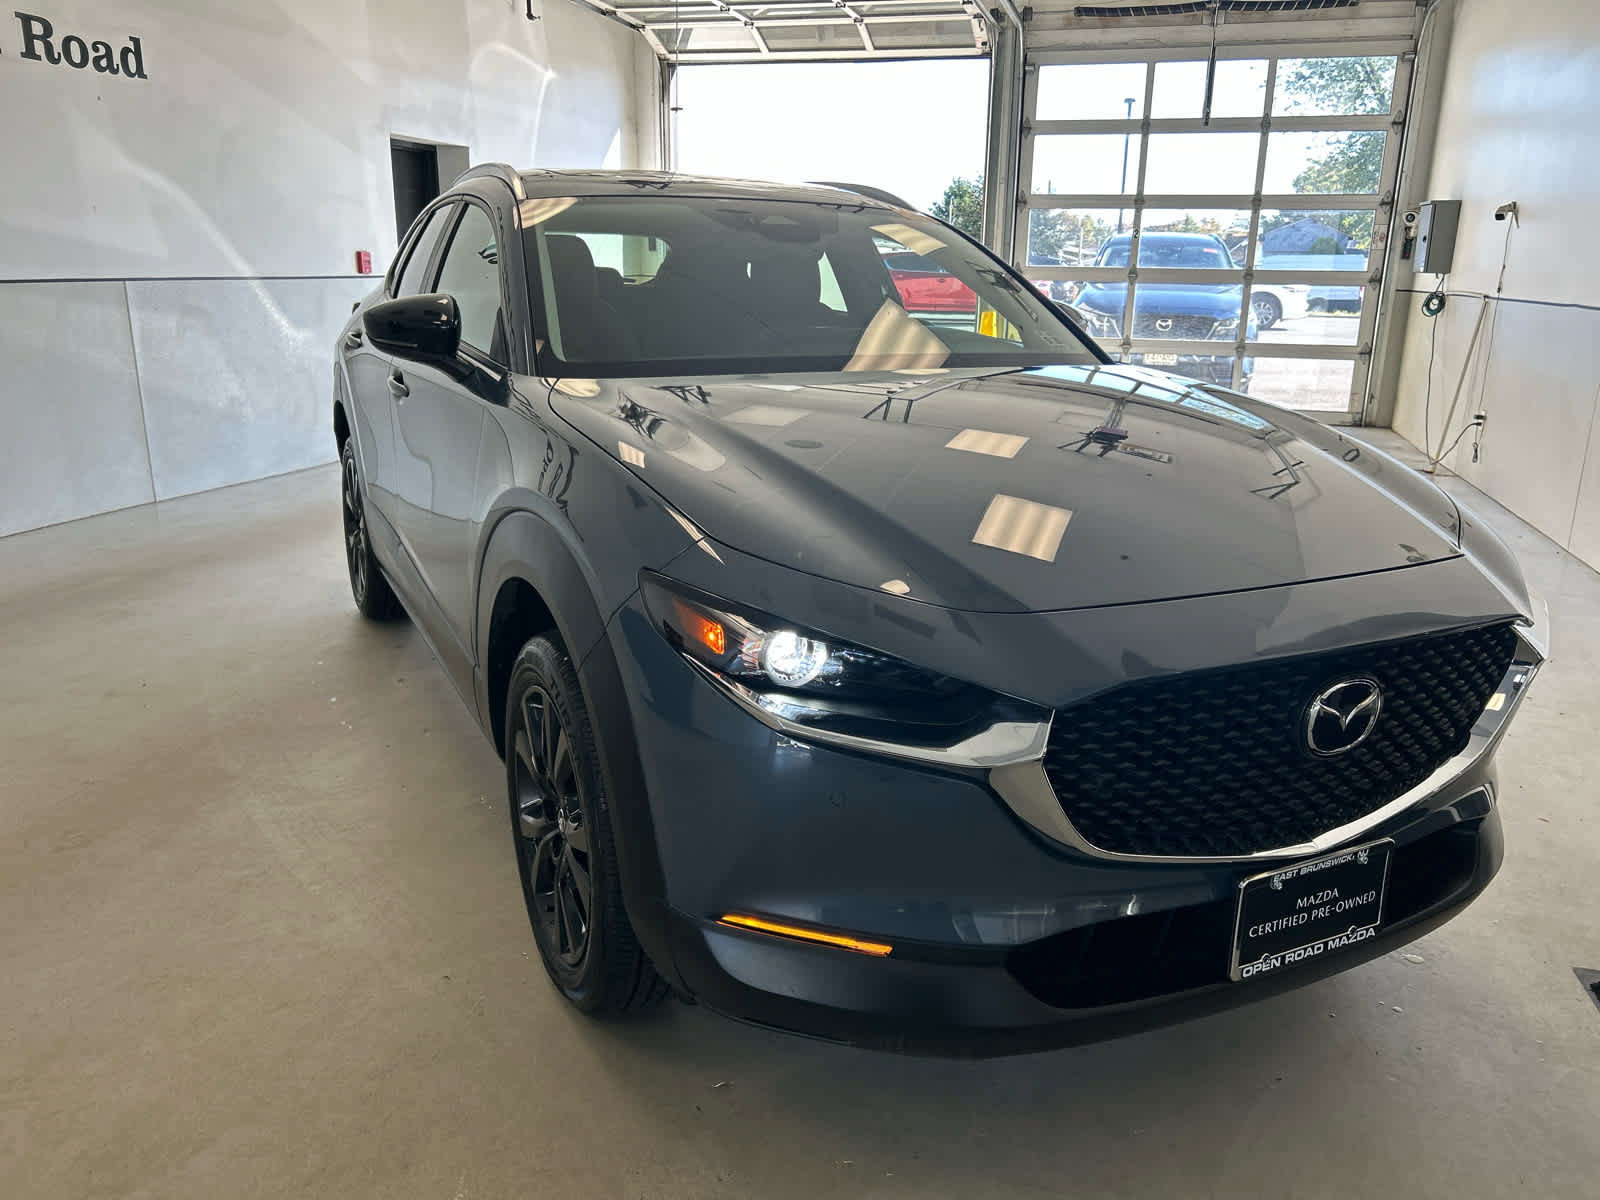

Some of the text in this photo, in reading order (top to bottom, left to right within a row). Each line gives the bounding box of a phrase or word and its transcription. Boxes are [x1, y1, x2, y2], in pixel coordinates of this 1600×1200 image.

[14, 11, 148, 80] Road
[1273, 870, 1298, 882] EAST
[1300, 852, 1355, 875] BRUNSWICK,
[1249, 890, 1376, 938] CERTIFIED PRE-OWNED
[1296, 888, 1339, 910] MAZDA
[1242, 928, 1376, 978] OPEN ROAD MAZDA
